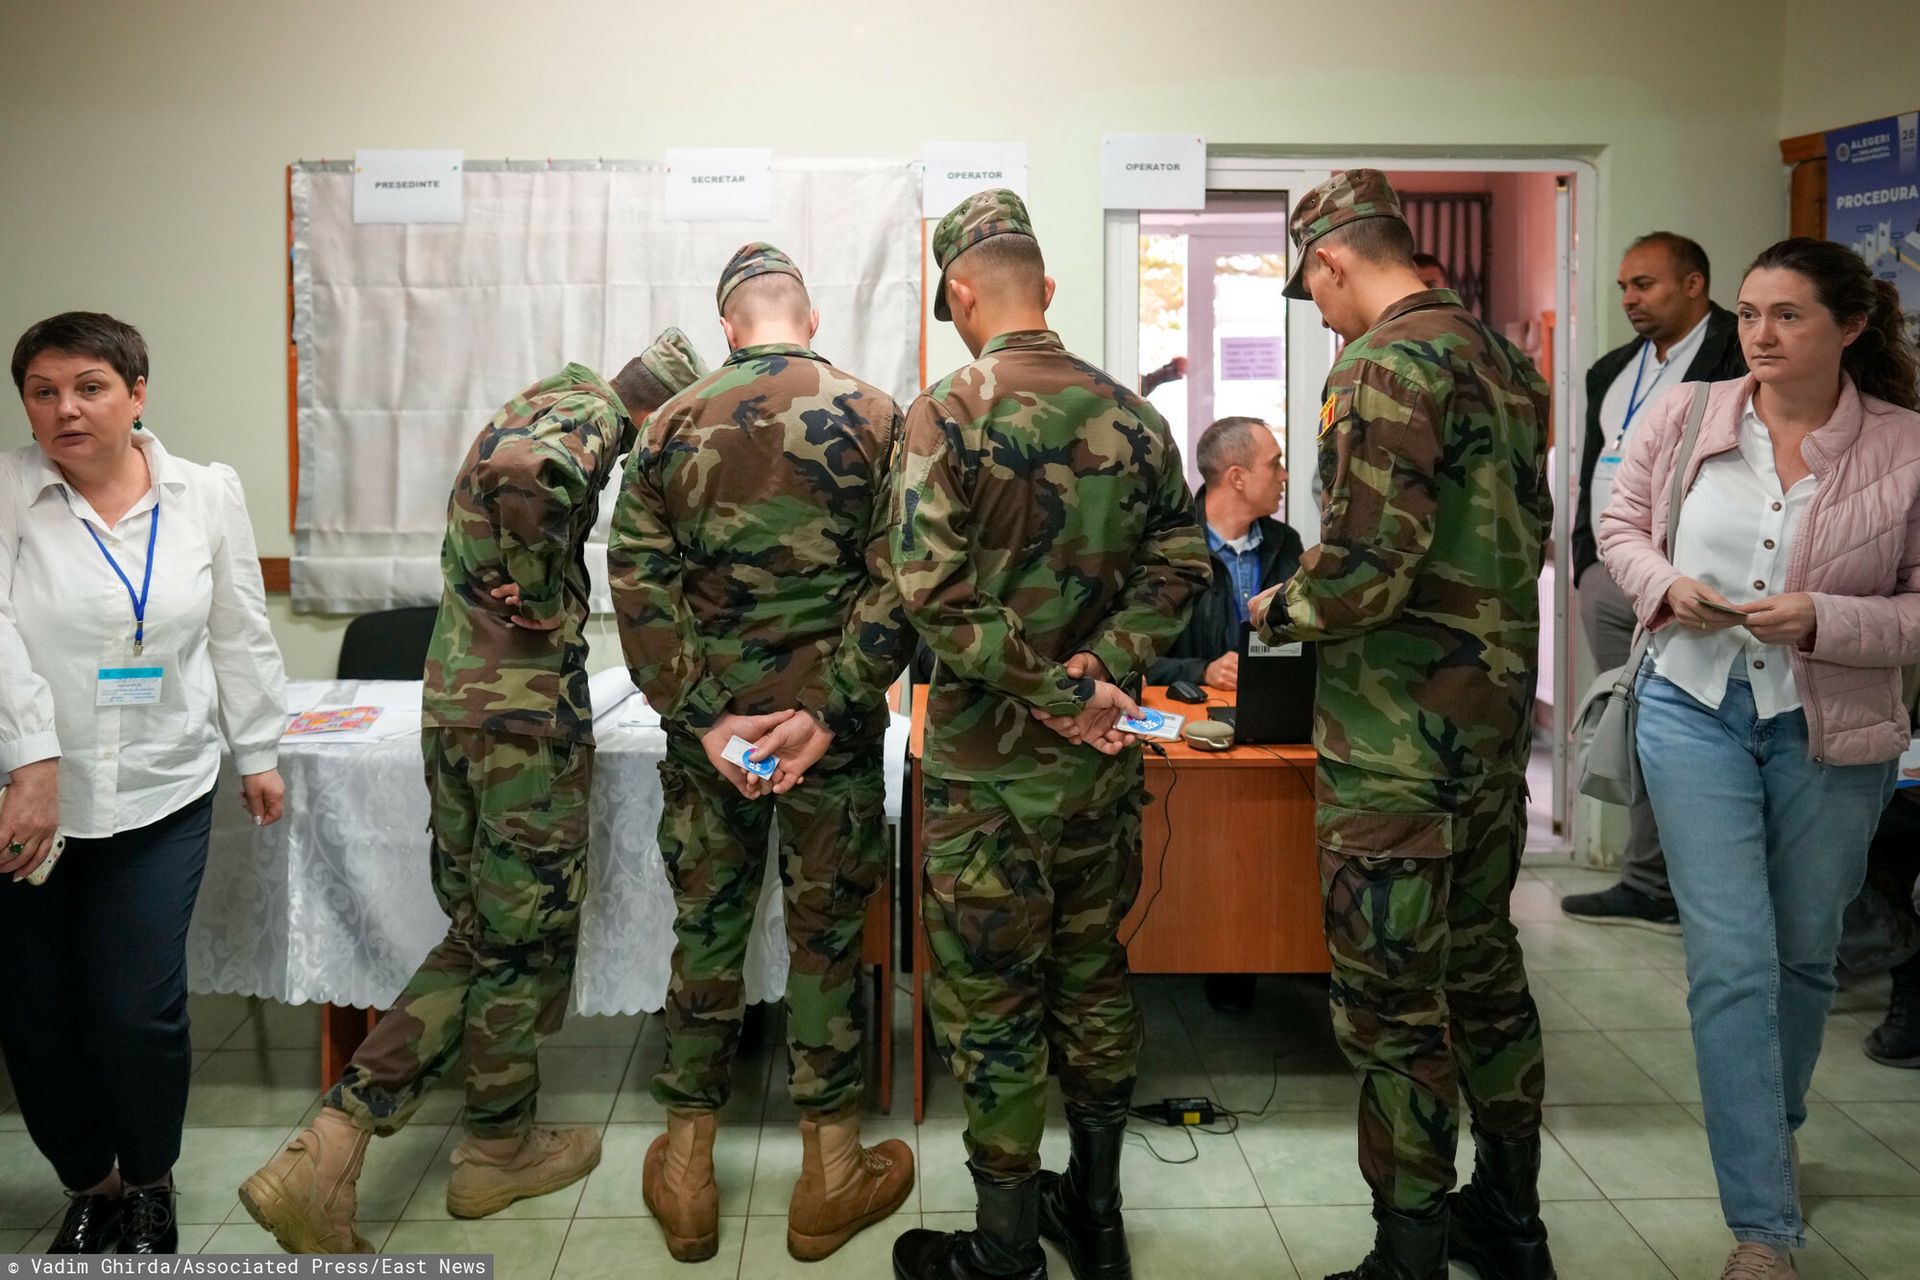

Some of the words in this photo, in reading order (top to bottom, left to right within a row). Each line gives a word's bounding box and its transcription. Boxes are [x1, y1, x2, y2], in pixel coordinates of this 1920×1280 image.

[1851, 134, 1890, 149] ALEGERI
[1125, 162, 1181, 171] OPERATOR
[691, 175, 745, 184] SECRETAR
[947, 171, 1003, 179] OPERATOR
[1836, 184, 1919, 210] PROCEDURA
